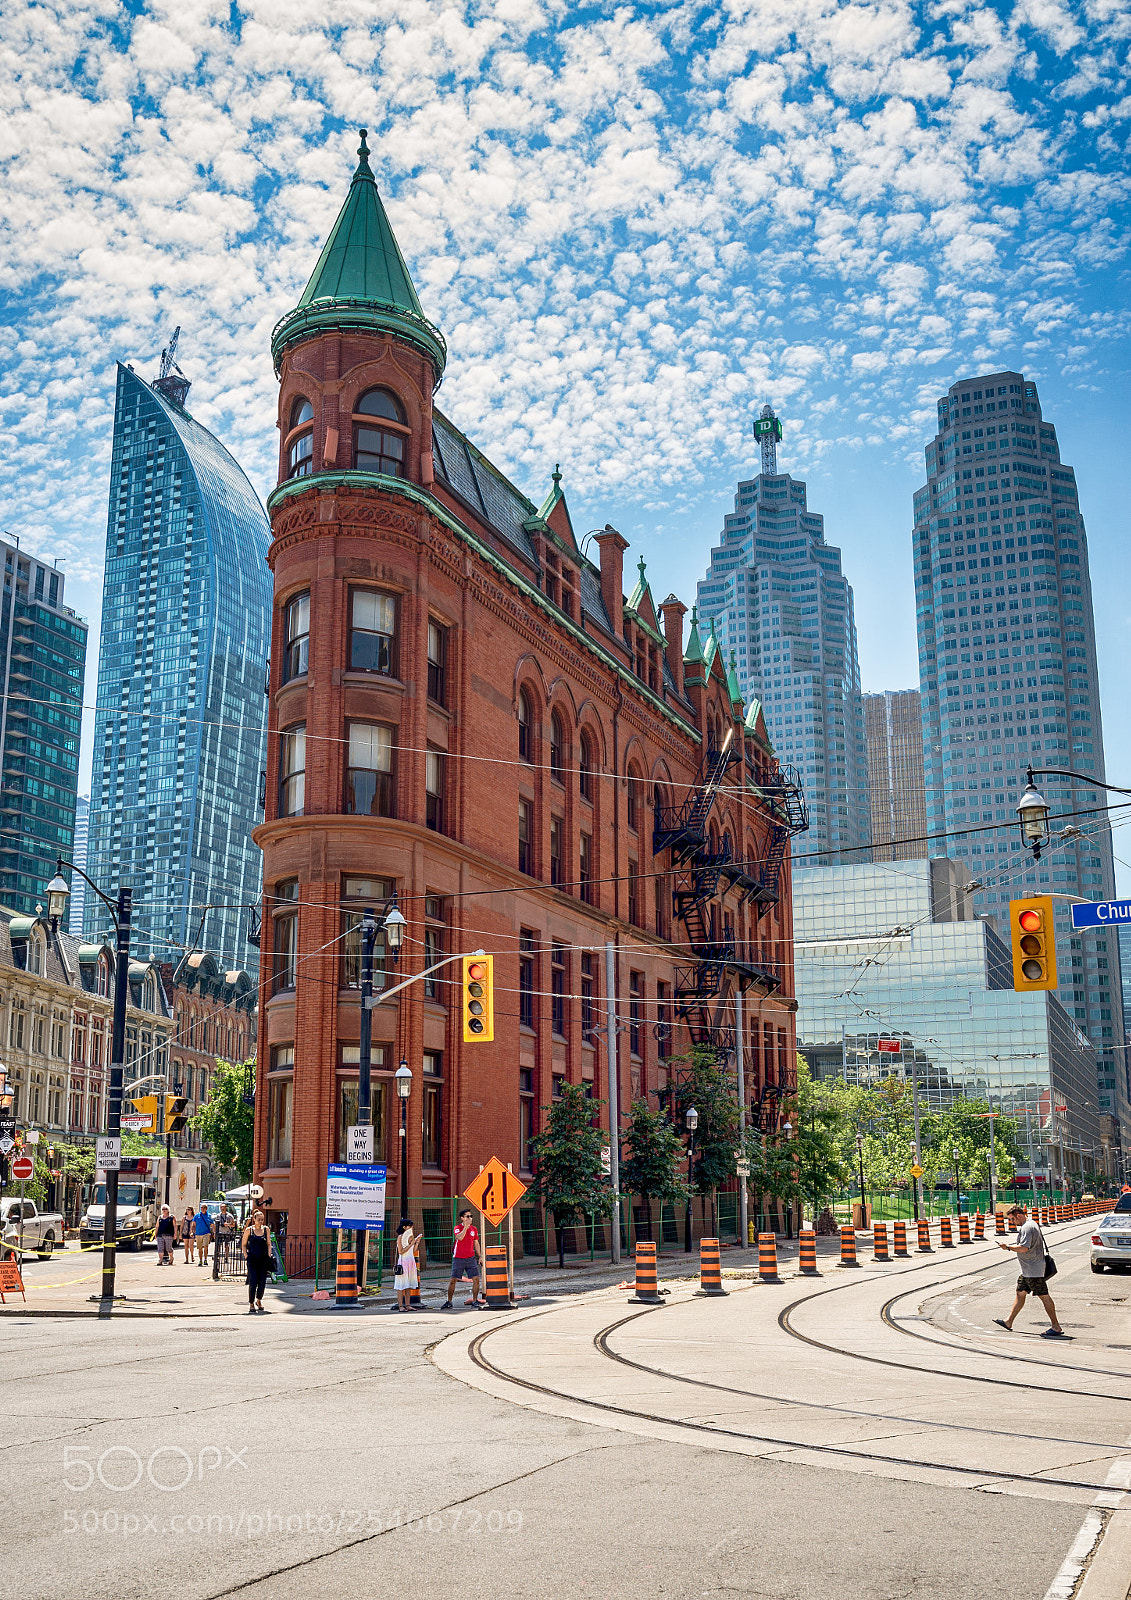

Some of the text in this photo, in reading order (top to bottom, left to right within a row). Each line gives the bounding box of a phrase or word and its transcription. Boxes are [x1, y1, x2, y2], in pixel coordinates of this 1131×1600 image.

[758, 420, 771, 430] TD
[354, 1129, 367, 1138] ONE
[105, 1140, 114, 1150] NO
[354, 1141, 367, 1149] WAY
[349, 1152, 372, 1160] BEGINS
